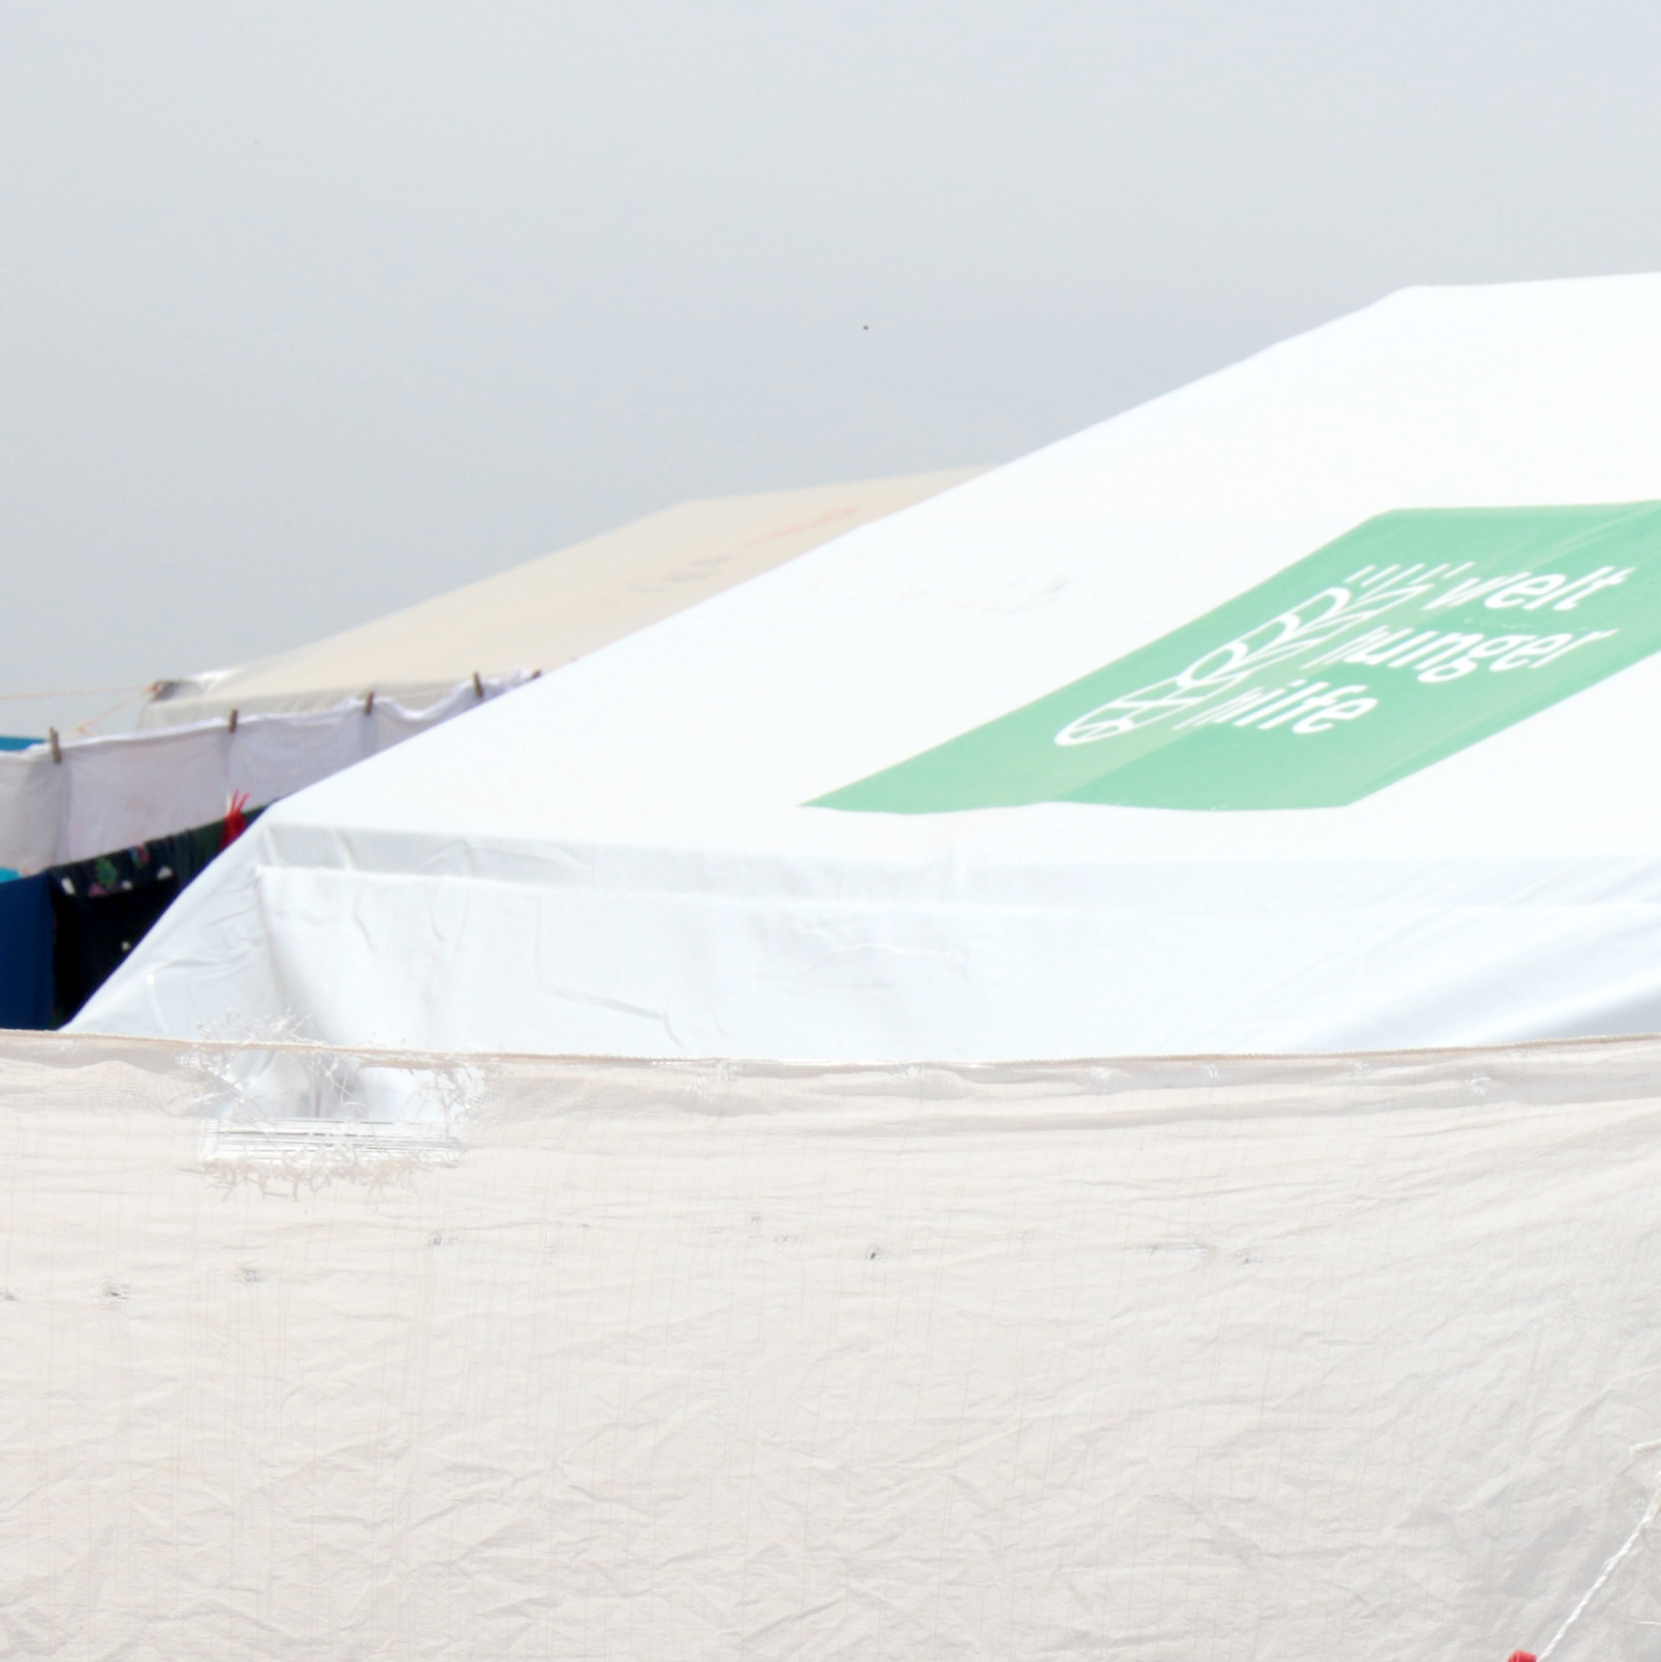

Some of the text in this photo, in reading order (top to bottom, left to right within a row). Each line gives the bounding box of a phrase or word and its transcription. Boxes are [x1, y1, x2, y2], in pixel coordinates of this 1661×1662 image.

[1423, 566, 1637, 611] welt
[1301, 626, 1620, 683] hunger
[1170, 679, 1378, 734] hilfe
